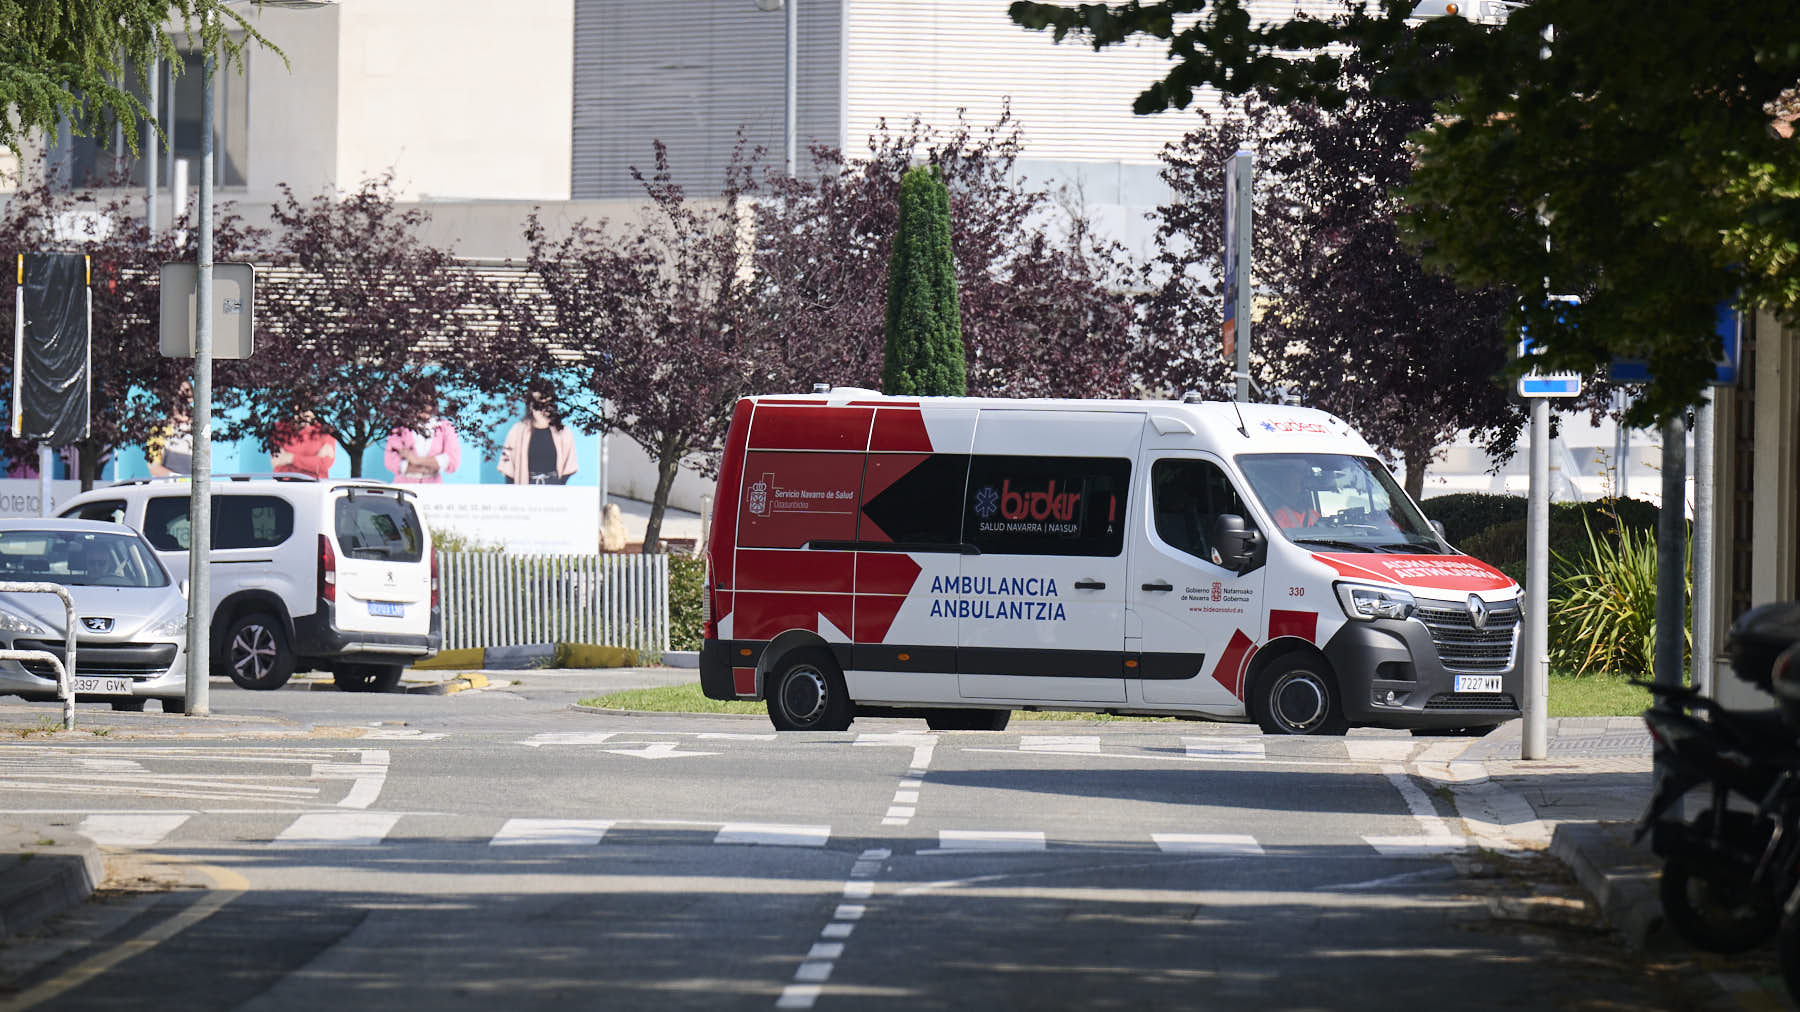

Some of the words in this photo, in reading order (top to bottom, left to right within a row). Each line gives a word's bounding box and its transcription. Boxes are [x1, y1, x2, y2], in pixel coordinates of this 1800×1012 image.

[775, 489, 799, 498] Servicio
[801, 490, 825, 499] Navarro
[826, 490, 834, 499] de
[835, 490, 854, 499] Salud
[980, 522, 1005, 531] SALUD
[1007, 523, 1042, 532] NAVARRA
[930, 575, 1058, 597] AMBULANCIA
[1185, 586, 1209, 594] Gobierno
[1288, 586, 1305, 597] 330
[930, 599, 1066, 621] ANBULANTZIA
[74, 679, 99, 691] 2397
[106, 680, 127, 691] GVK
[1461, 677, 1483, 690] 7227
